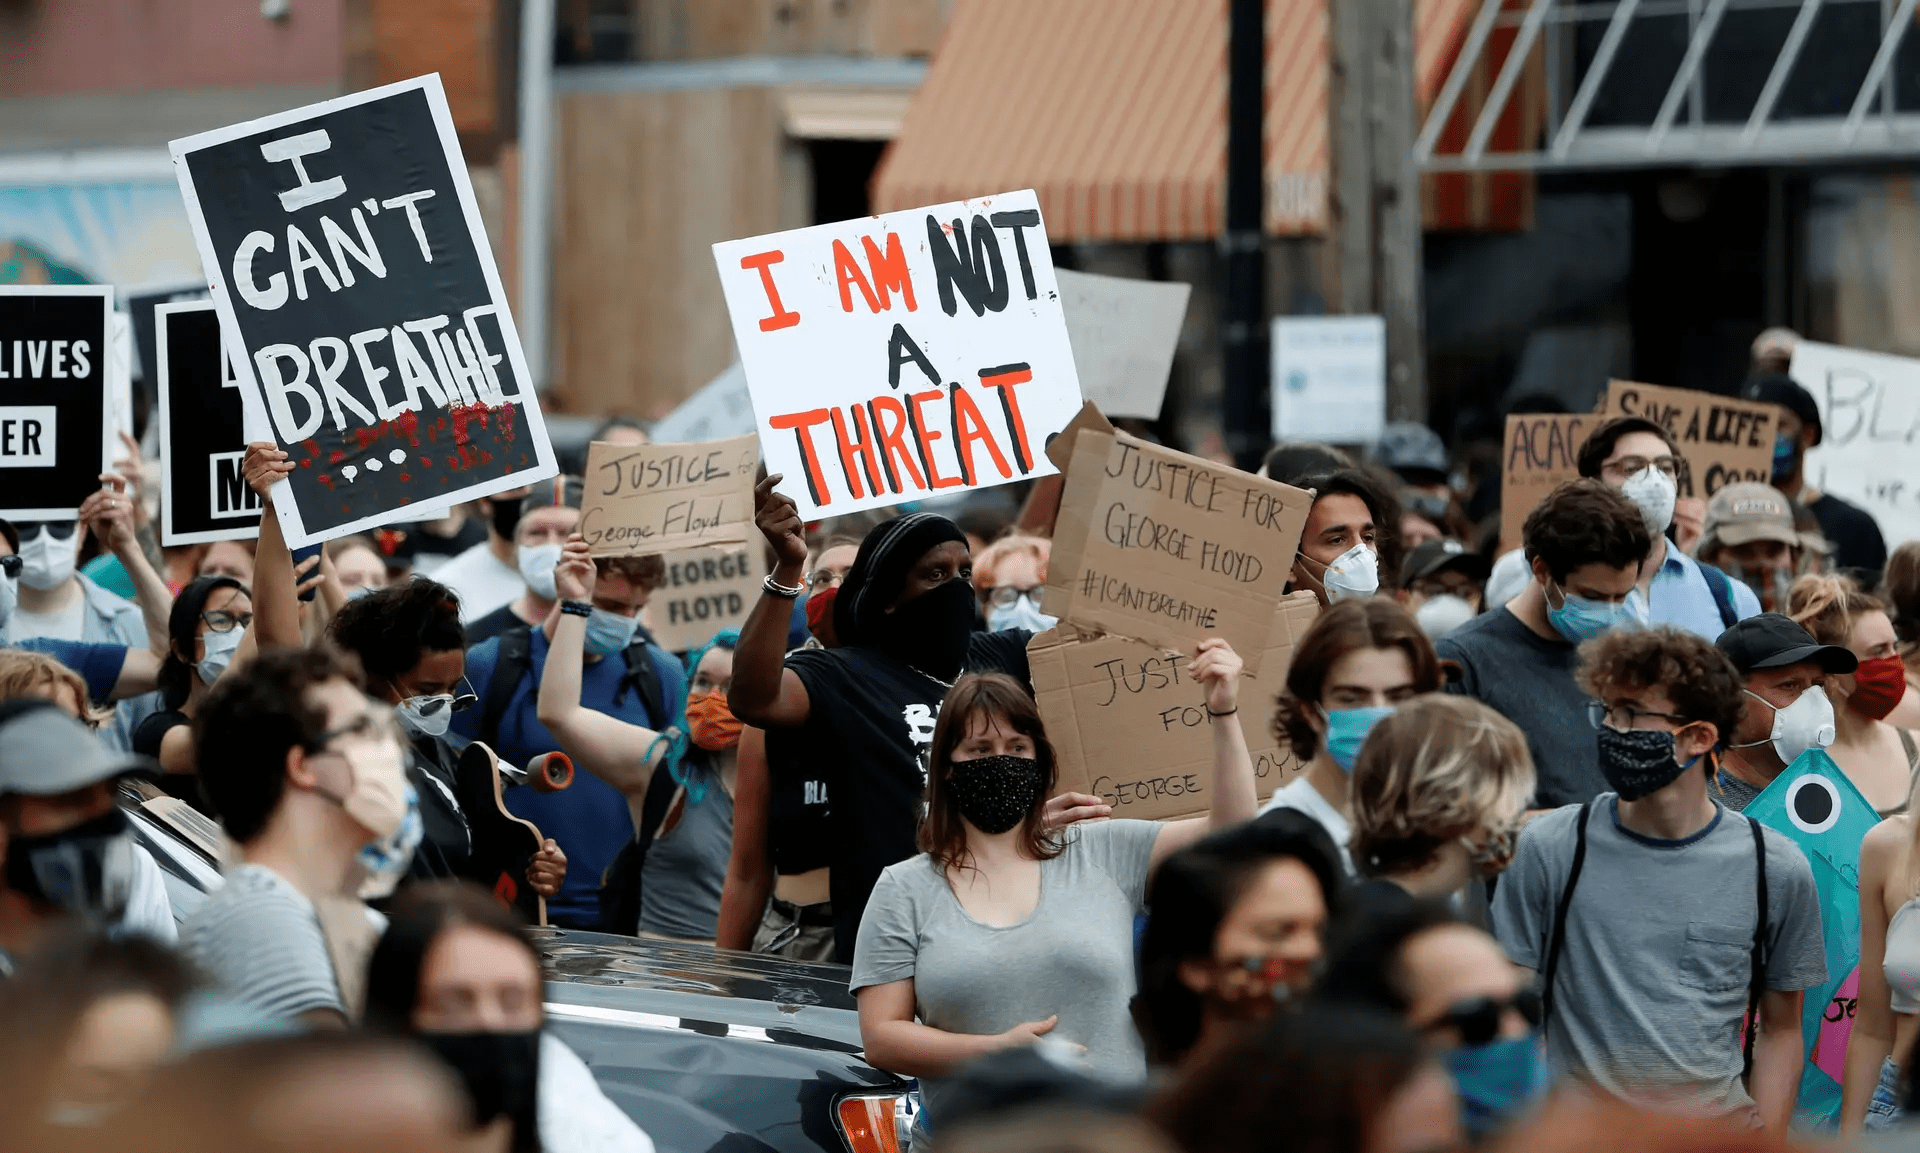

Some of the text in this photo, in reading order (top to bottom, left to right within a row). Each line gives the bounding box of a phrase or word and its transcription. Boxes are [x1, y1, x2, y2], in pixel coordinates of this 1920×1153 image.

[260, 129, 347, 212] I
[233, 189, 436, 311] CAN'T
[740, 208, 1040, 332] I AM NOT
[254, 303, 522, 445] BREATHE
[888, 322, 942, 389] A
[768, 361, 1034, 507] THREAT
[1684, 405, 1701, 447] A
[600, 450, 732, 496] JUSTICE
[1105, 440, 1284, 533] JUSTICE FOR
[581, 499, 724, 549] George Floyd
[1105, 502, 1264, 583] GEORGE FLOYD
[670, 552, 750, 588] EORGE
[1080, 568, 1219, 629] #ICANTBREATHE
[667, 591, 743, 627] FLOYD
[1092, 774, 1204, 810] GEORGE
